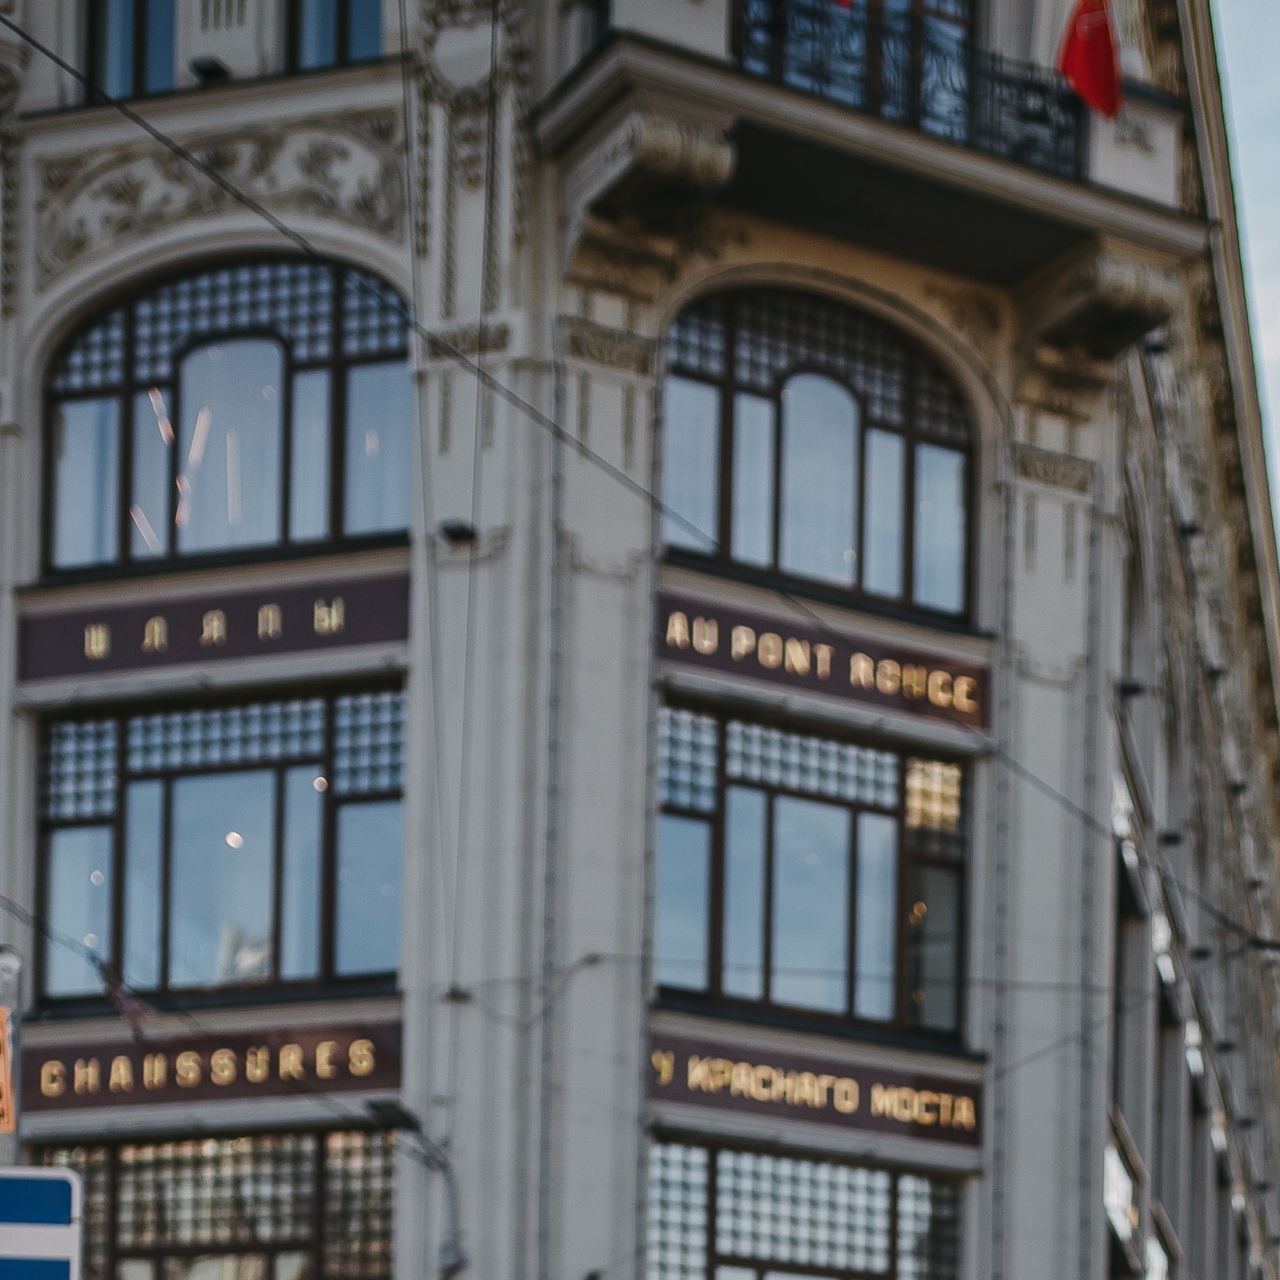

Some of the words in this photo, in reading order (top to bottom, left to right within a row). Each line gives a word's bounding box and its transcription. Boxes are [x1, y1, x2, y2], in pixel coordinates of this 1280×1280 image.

[84, 596, 345, 660] ШЛЯПЫ
[665, 611, 719, 655] AU
[731, 625, 835, 680] PONT
[850, 652, 979, 713] ROUGE
[40, 1039, 375, 1098] CHAUSSURES
[651, 1050, 675, 1087] У
[687, 1054, 860, 1114] КРАСНАГО
[870, 1082, 976, 1132] МОСТА
